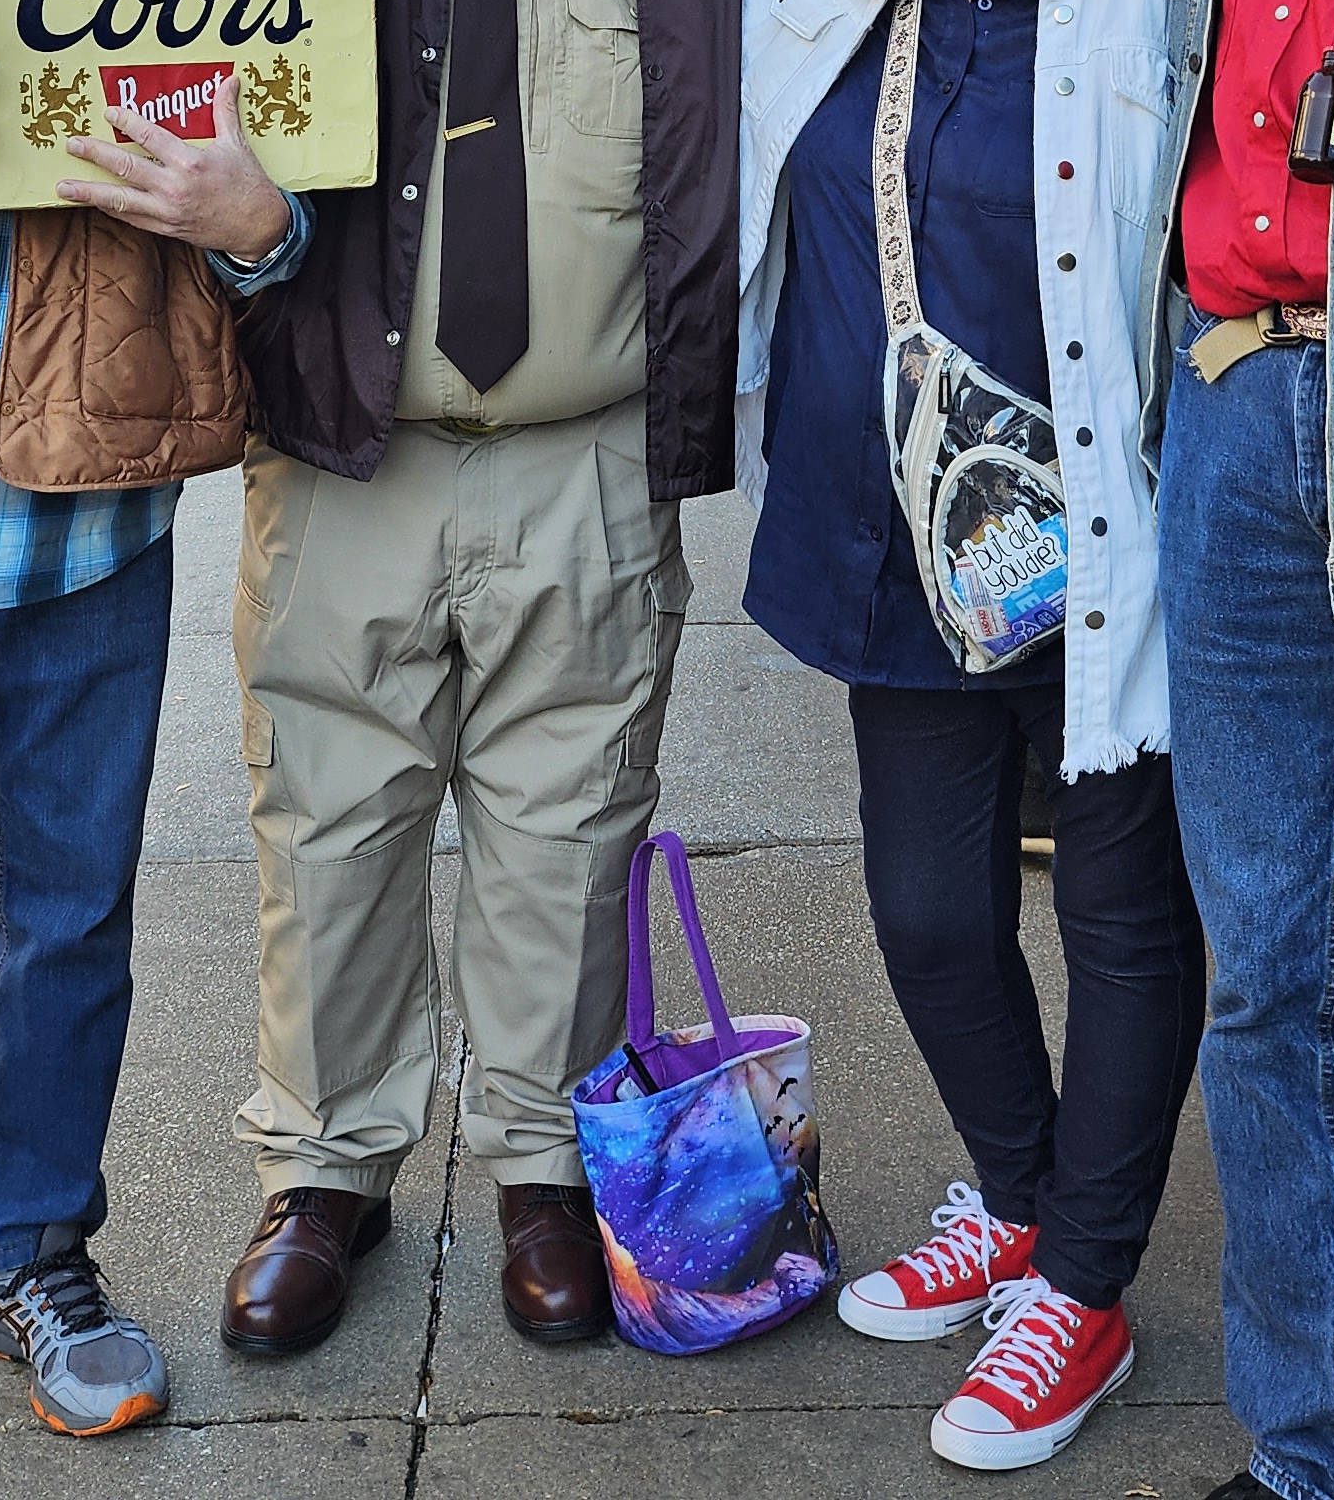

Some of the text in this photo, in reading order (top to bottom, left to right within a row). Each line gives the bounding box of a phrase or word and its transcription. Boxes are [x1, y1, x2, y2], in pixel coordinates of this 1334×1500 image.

[966, 510, 1039, 571] but did
[985, 558, 1028, 596] you
[1025, 536, 1062, 574] die?
